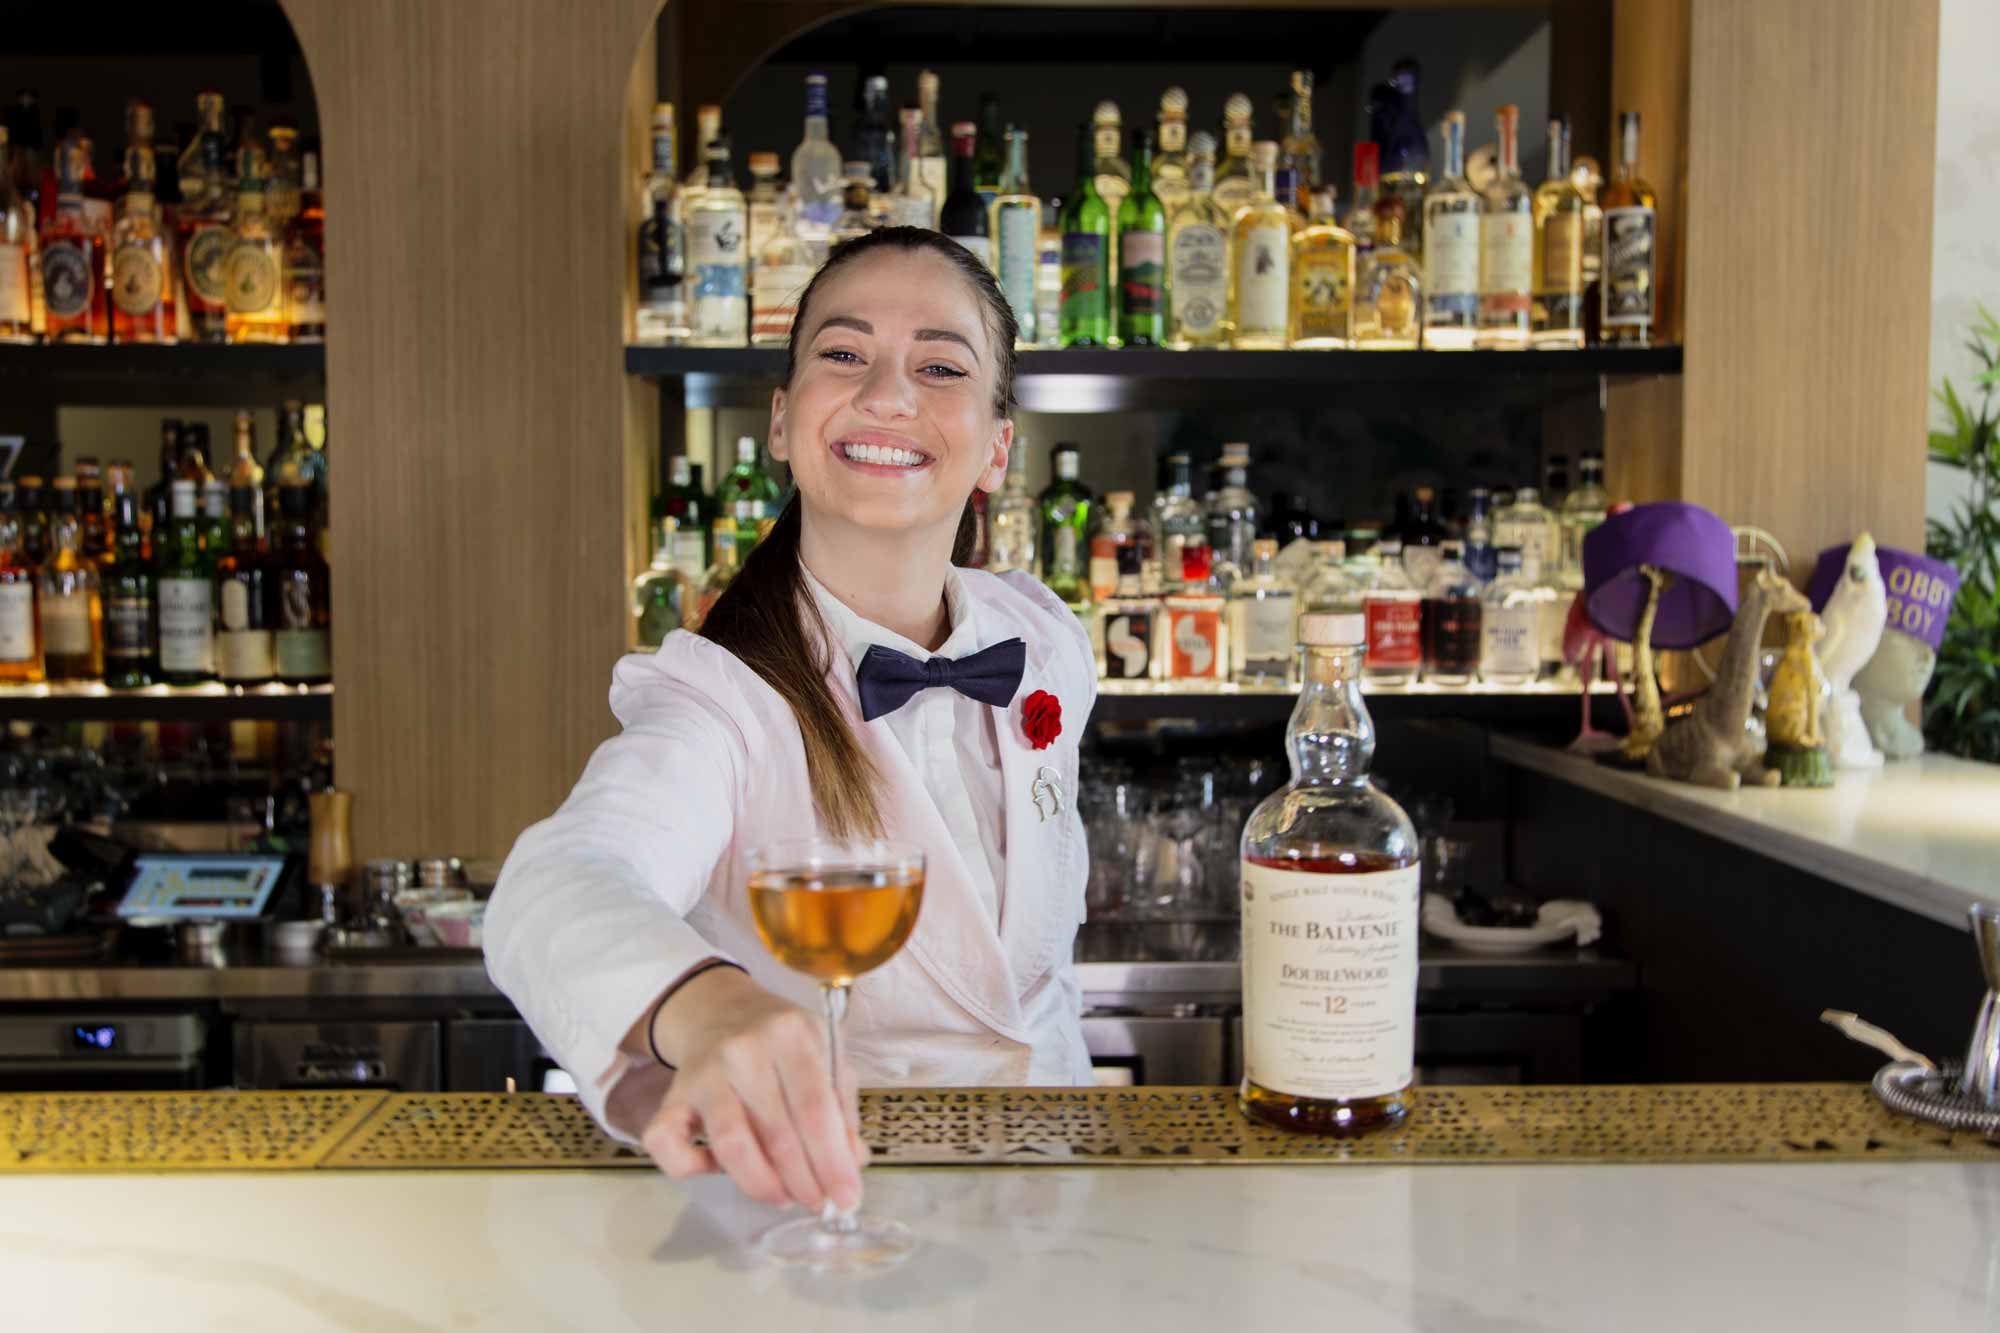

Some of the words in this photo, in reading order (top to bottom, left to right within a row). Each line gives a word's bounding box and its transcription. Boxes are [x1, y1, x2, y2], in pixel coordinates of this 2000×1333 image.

[1888, 565, 1952, 608] OBBY
[1886, 596, 1936, 635] BOY
[1269, 920, 1298, 935] THE
[1306, 920, 1400, 941] BALVENIE
[1325, 995, 1348, 1015] 12
